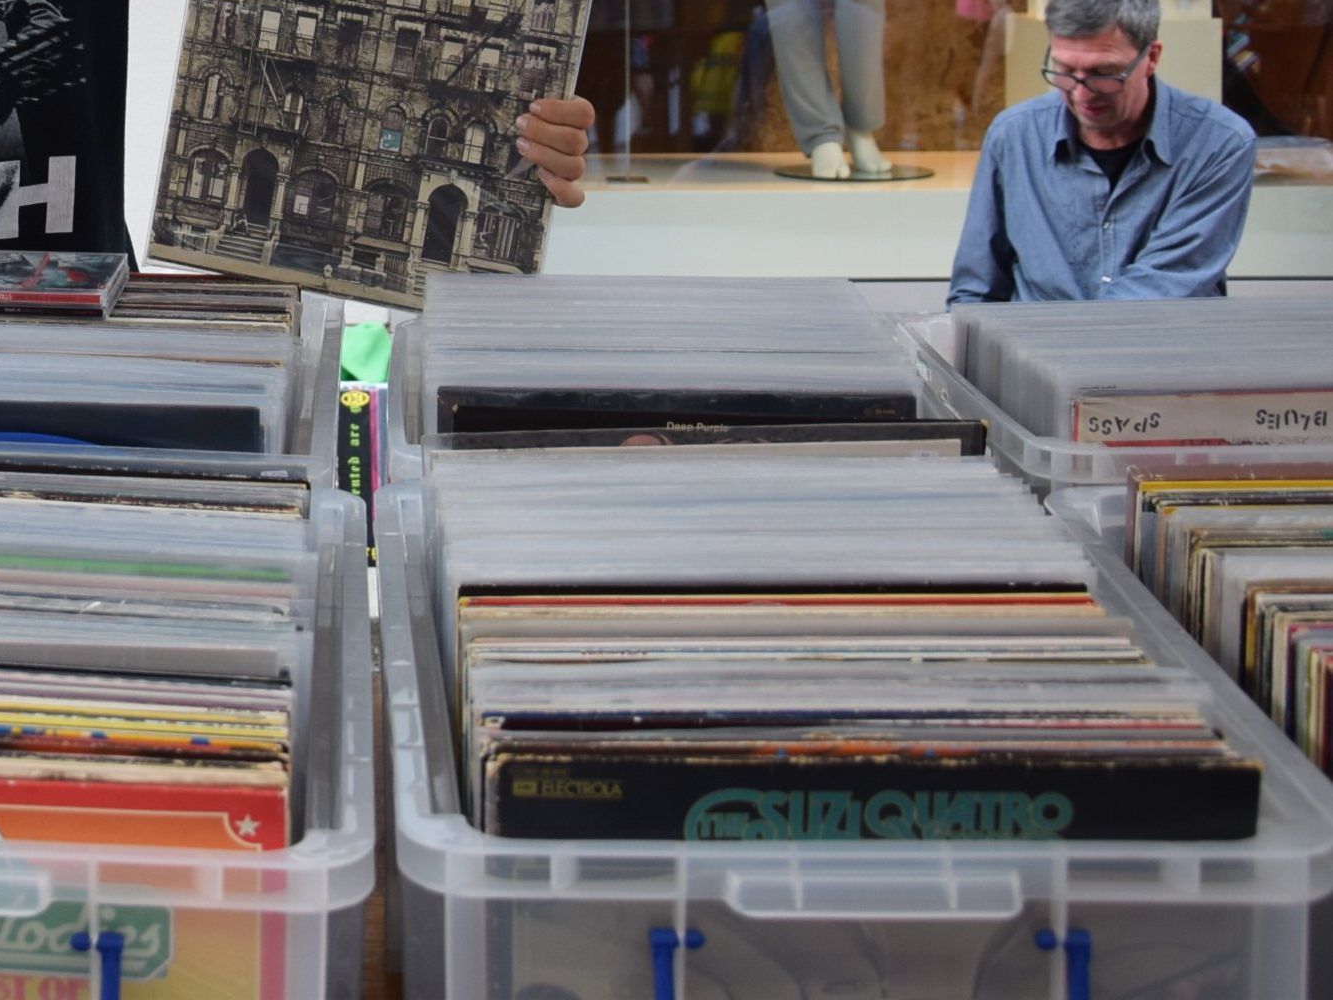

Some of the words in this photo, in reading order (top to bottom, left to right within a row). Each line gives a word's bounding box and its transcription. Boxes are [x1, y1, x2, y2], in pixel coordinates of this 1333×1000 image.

[666, 420, 693, 432] Deep
[696, 421, 730, 433] Purple
[1089, 412, 1161, 435] SPASS
[1255, 409, 1328, 431] BLUES
[758, 789, 861, 840] SUZI
[864, 789, 1075, 840] QUATRO
